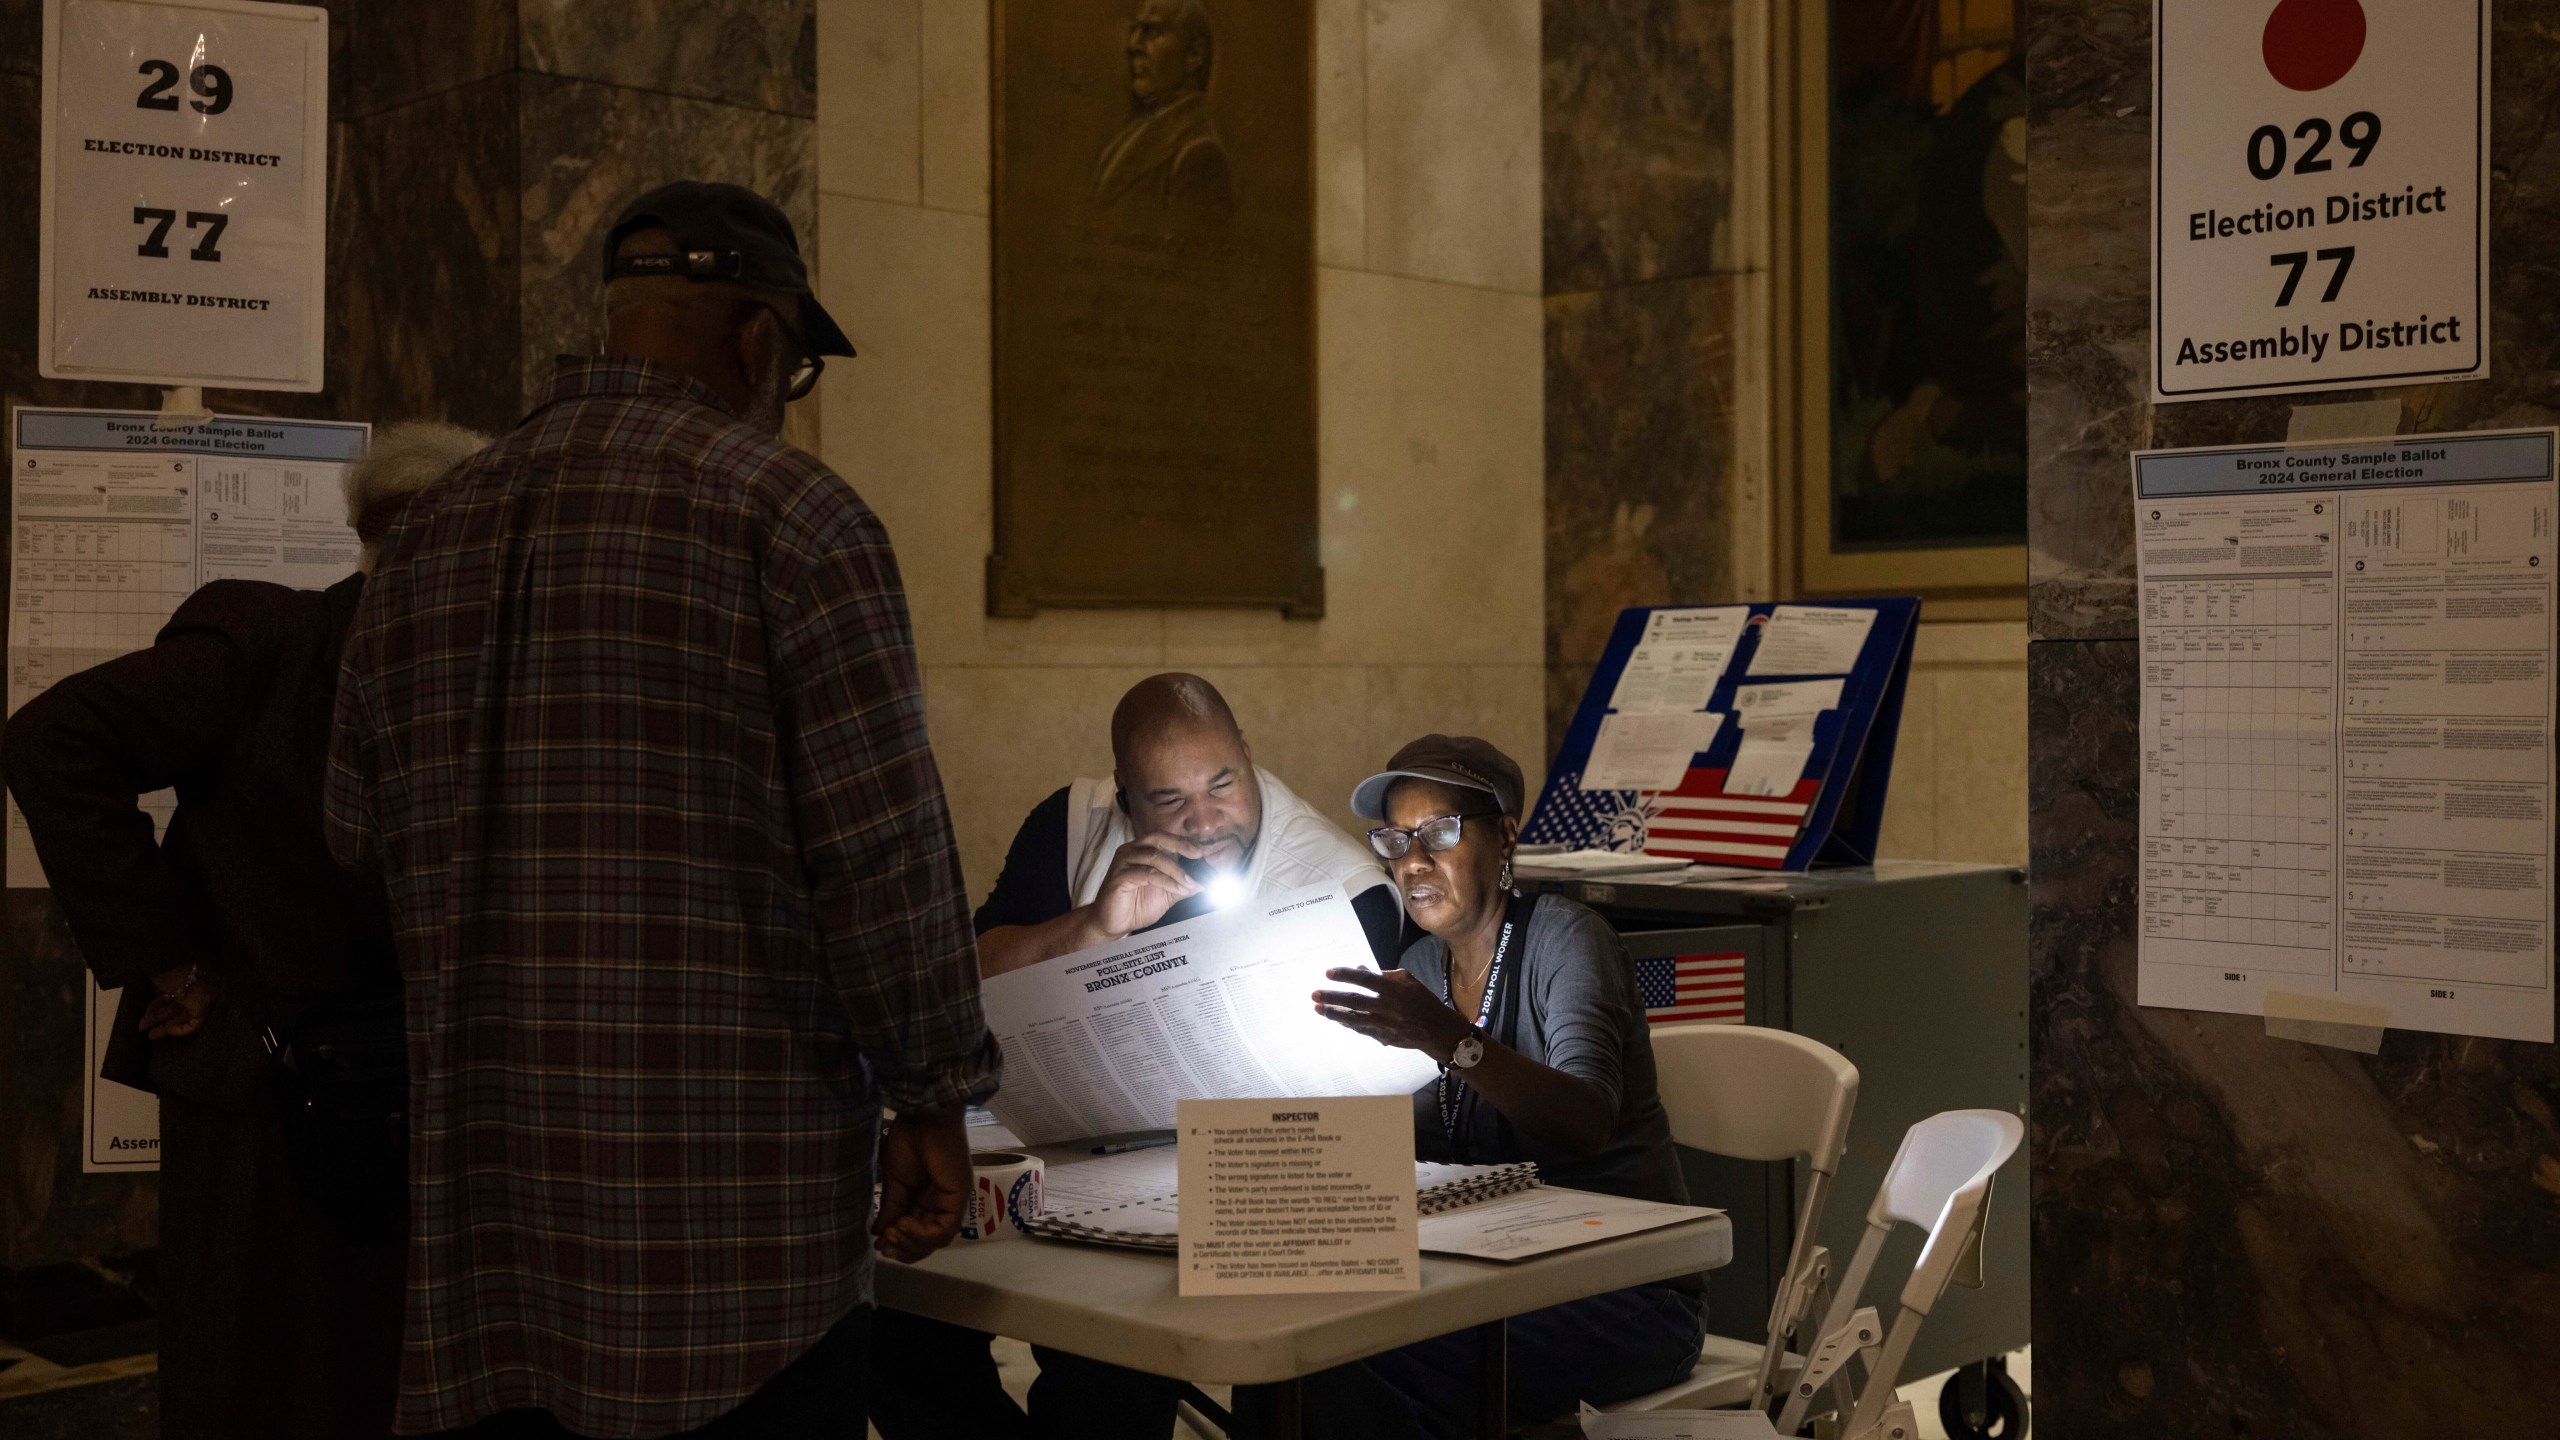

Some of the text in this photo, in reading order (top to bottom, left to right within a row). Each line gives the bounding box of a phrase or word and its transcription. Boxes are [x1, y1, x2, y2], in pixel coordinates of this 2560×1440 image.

[137, 59, 234, 115] 29
[84, 139, 281, 167] ELECTION DISTRICT
[2246, 111, 2382, 181] 029
[2189, 185, 2447, 241] Election District
[133, 206, 228, 262] 77
[2270, 246, 2355, 308] 77
[87, 288, 270, 311] ASSEMBLY DISTRICT
[2176, 314, 2461, 366] Assembly District
[107, 422, 284, 440] Bronx County Sample Ballot
[126, 435, 265, 451] 2024 General Election
[2236, 449, 2446, 470] Bronx County Sample Ballot
[2259, 466, 2424, 485] 2024 General Election
[2349, 696, 2354, 705] 2
[2349, 760, 2354, 768] 3
[2349, 828, 2353, 836] 4
[2349, 891, 2354, 900] 5
[1096, 950, 1167, 977] POLL SITE LIST
[1102, 951, 1134, 965] GENERAL
[1134, 941, 1167, 955] ELECTION
[1084, 955, 1189, 993] BRONX COUNTY
[1482, 922, 1514, 1014] 2024 POLL WORKER
[2224, 972, 2246, 982] SIDE 1
[2430, 989, 2455, 999] SIDE 2
[1272, 1112, 1319, 1122] INSPECTOR
[109, 1136, 160, 1150] Assem
[1205, 1240, 1224, 1248] MUST
[1282, 1238, 1315, 1246] AFFIDAVIT
[1317, 1238, 1342, 1246] BALLOT
